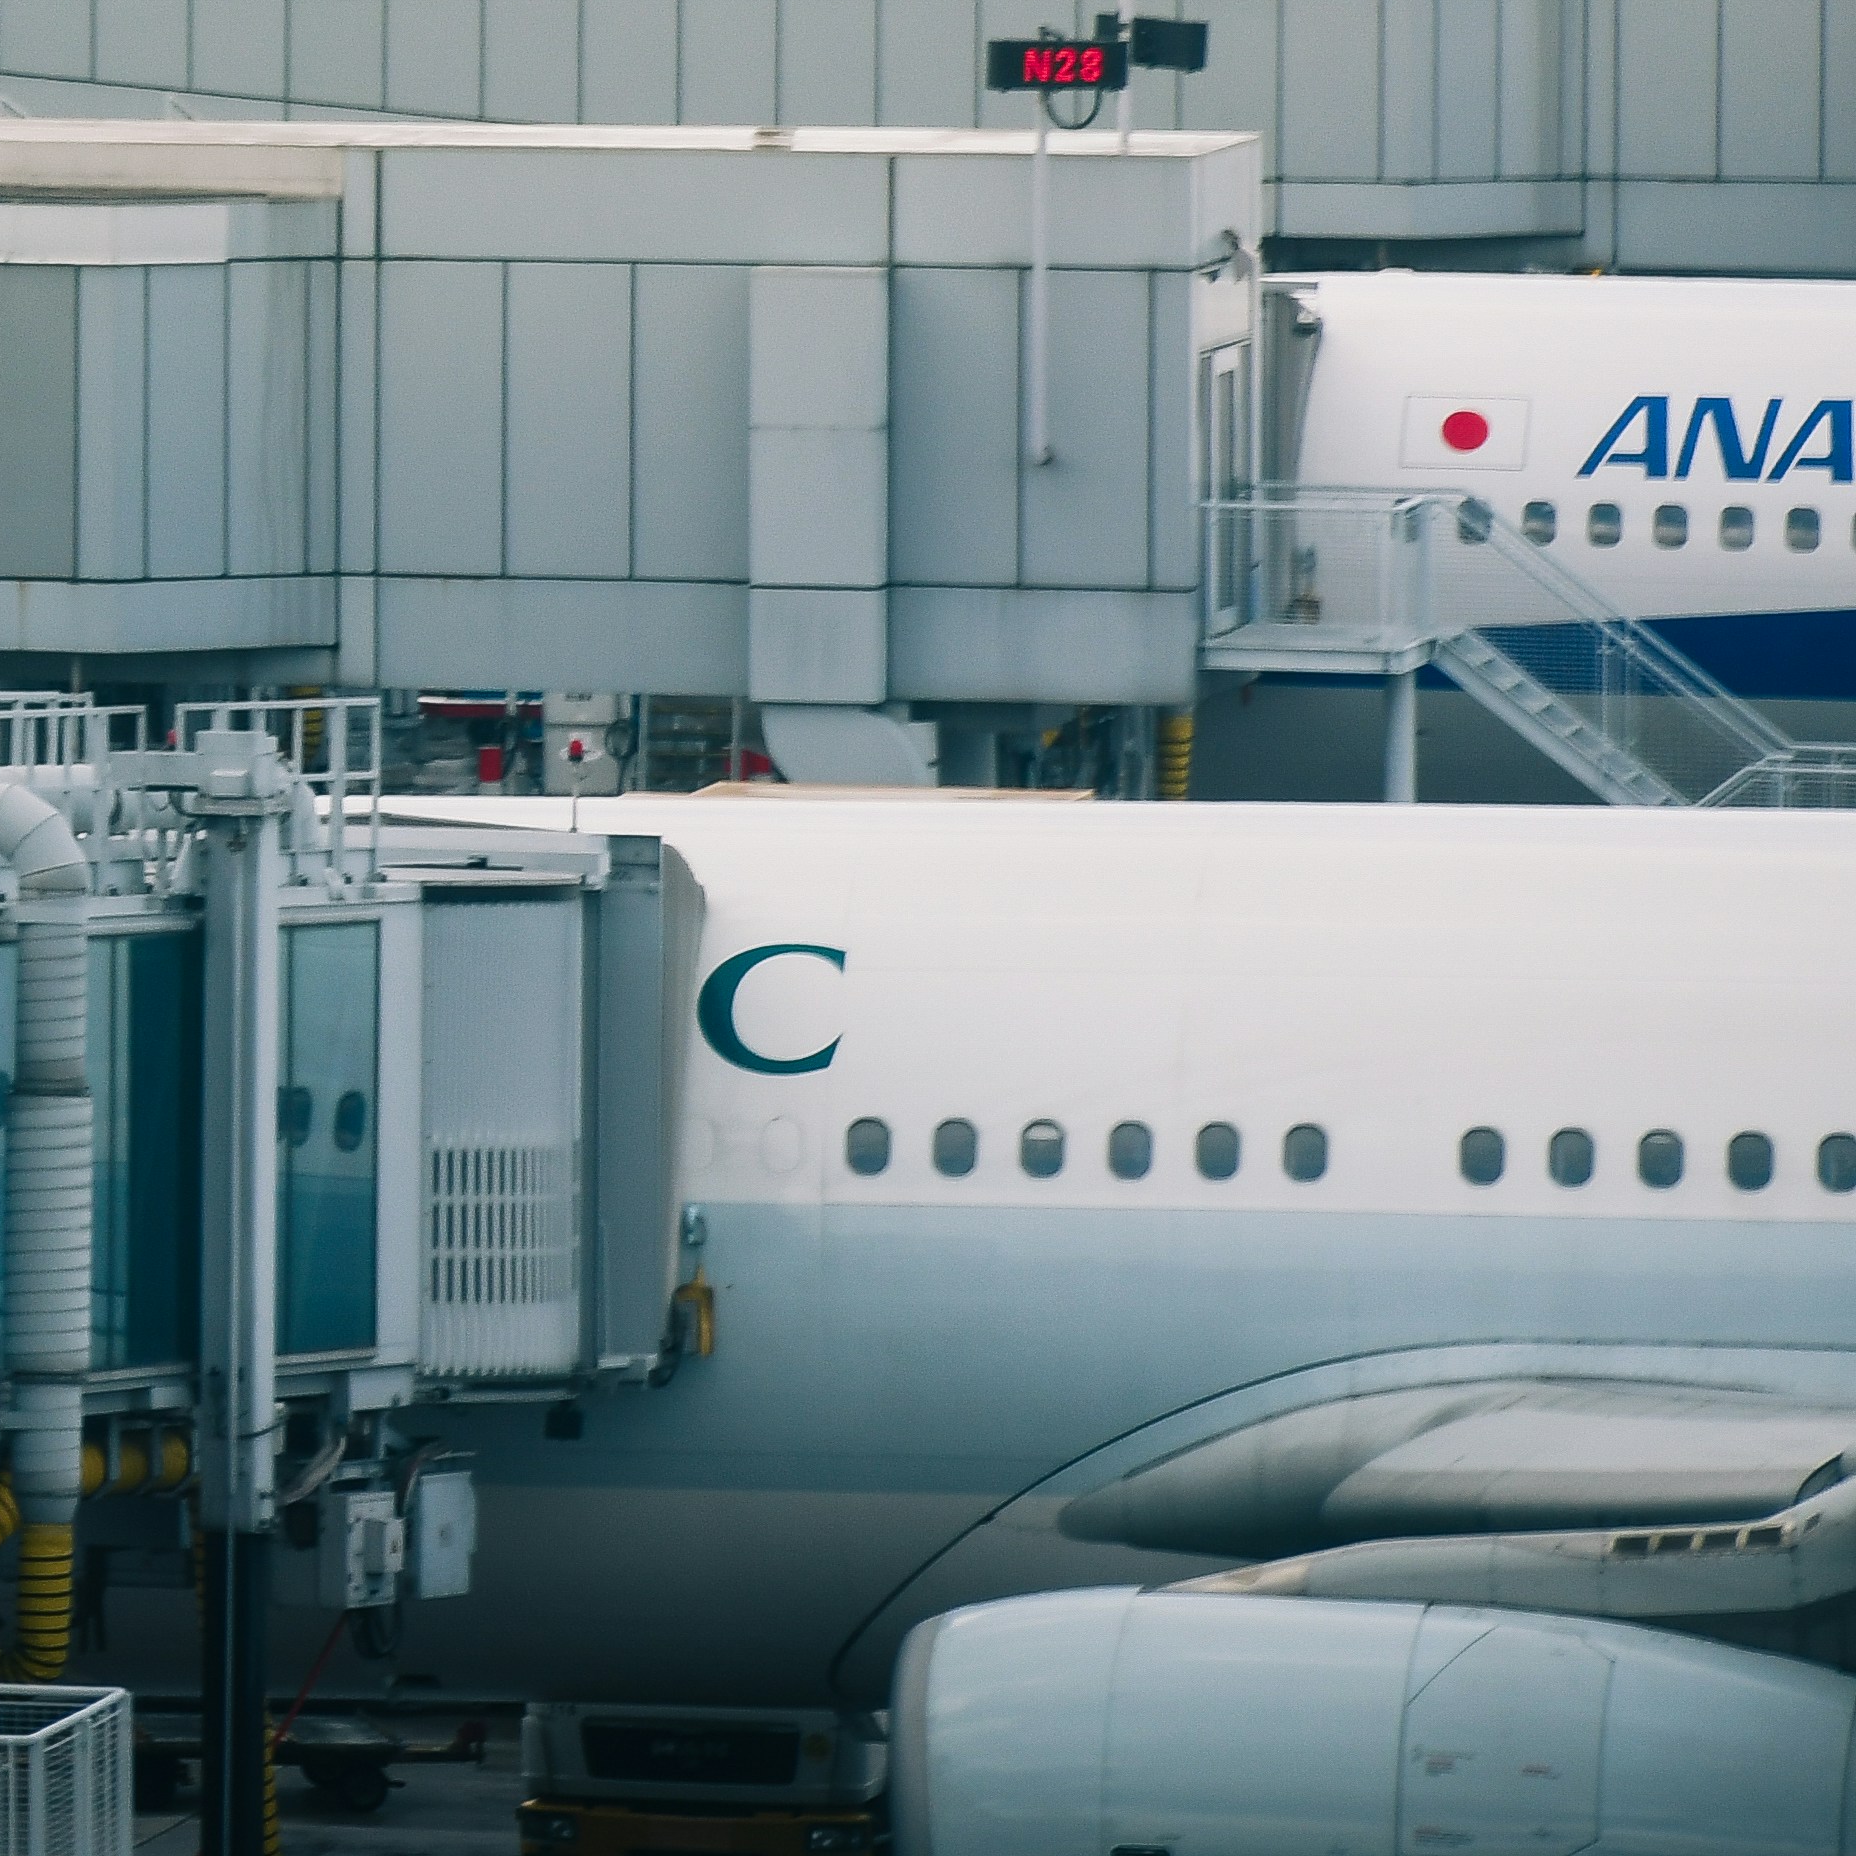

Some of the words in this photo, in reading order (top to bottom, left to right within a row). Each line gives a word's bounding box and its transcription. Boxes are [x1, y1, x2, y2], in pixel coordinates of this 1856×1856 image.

[1023, 47, 1104, 82] N28
[1576, 395, 1854, 482] ANA
[697, 943, 847, 1075] C
